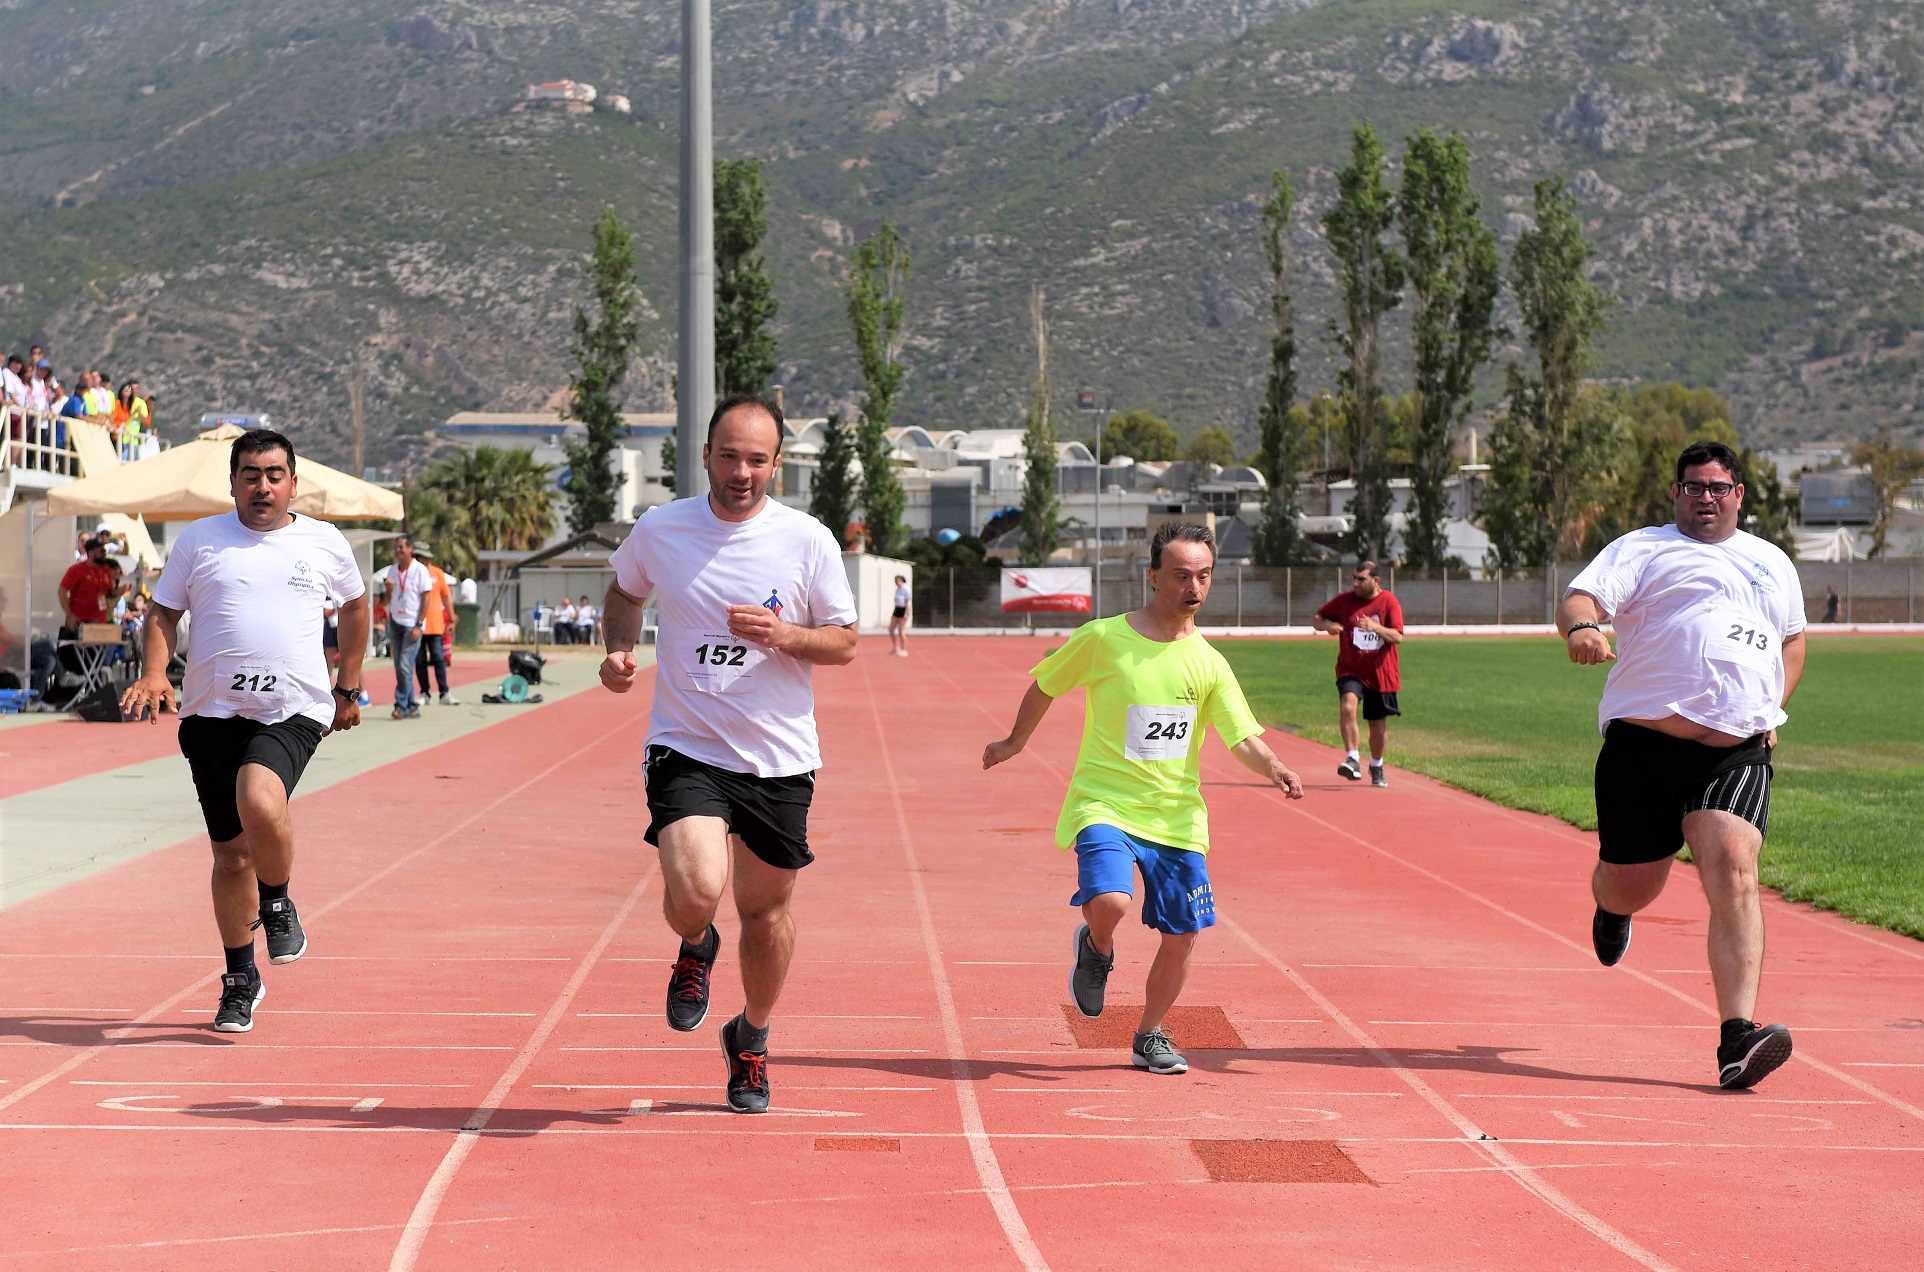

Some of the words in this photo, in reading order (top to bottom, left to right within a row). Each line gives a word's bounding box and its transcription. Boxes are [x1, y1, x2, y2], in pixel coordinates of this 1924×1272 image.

[1727, 624, 1768, 650] 213
[696, 644, 747, 666] 152
[231, 674, 277, 692] 212
[1145, 722, 1188, 740] 243
